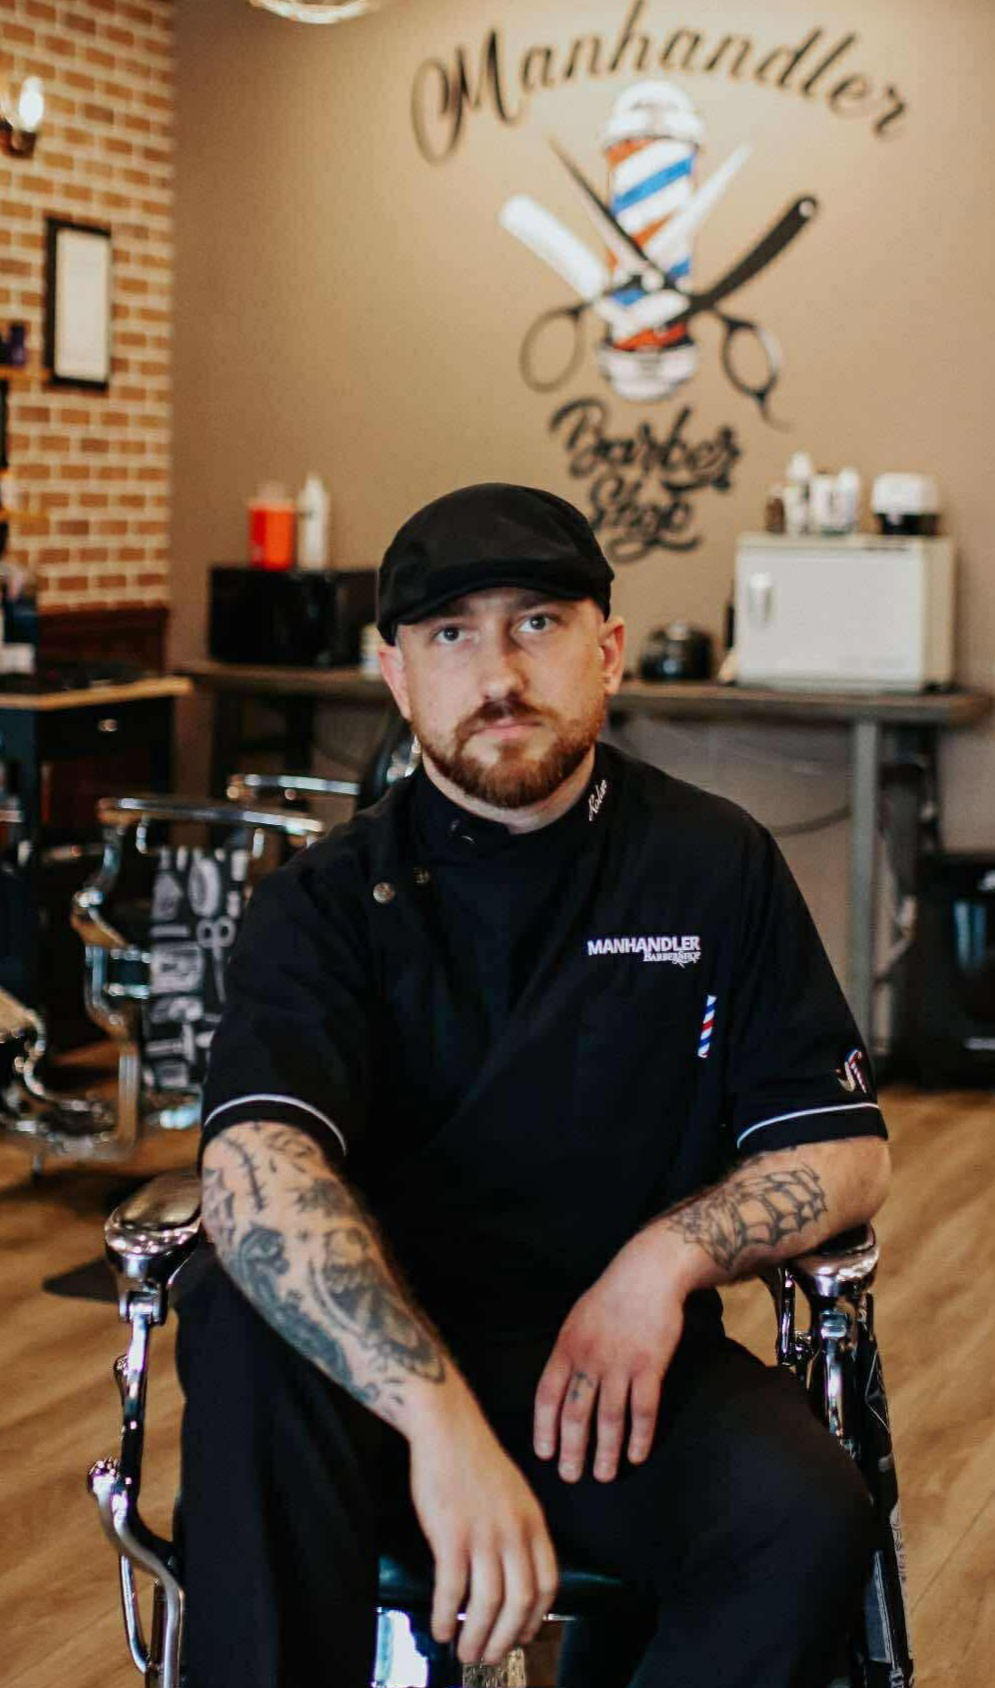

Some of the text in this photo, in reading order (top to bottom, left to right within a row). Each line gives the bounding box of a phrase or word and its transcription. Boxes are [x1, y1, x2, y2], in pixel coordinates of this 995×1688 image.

[411, 0, 908, 166] Manhandler
[549, 397, 742, 493] Barber
[587, 935, 701, 956] MANHANDLER
